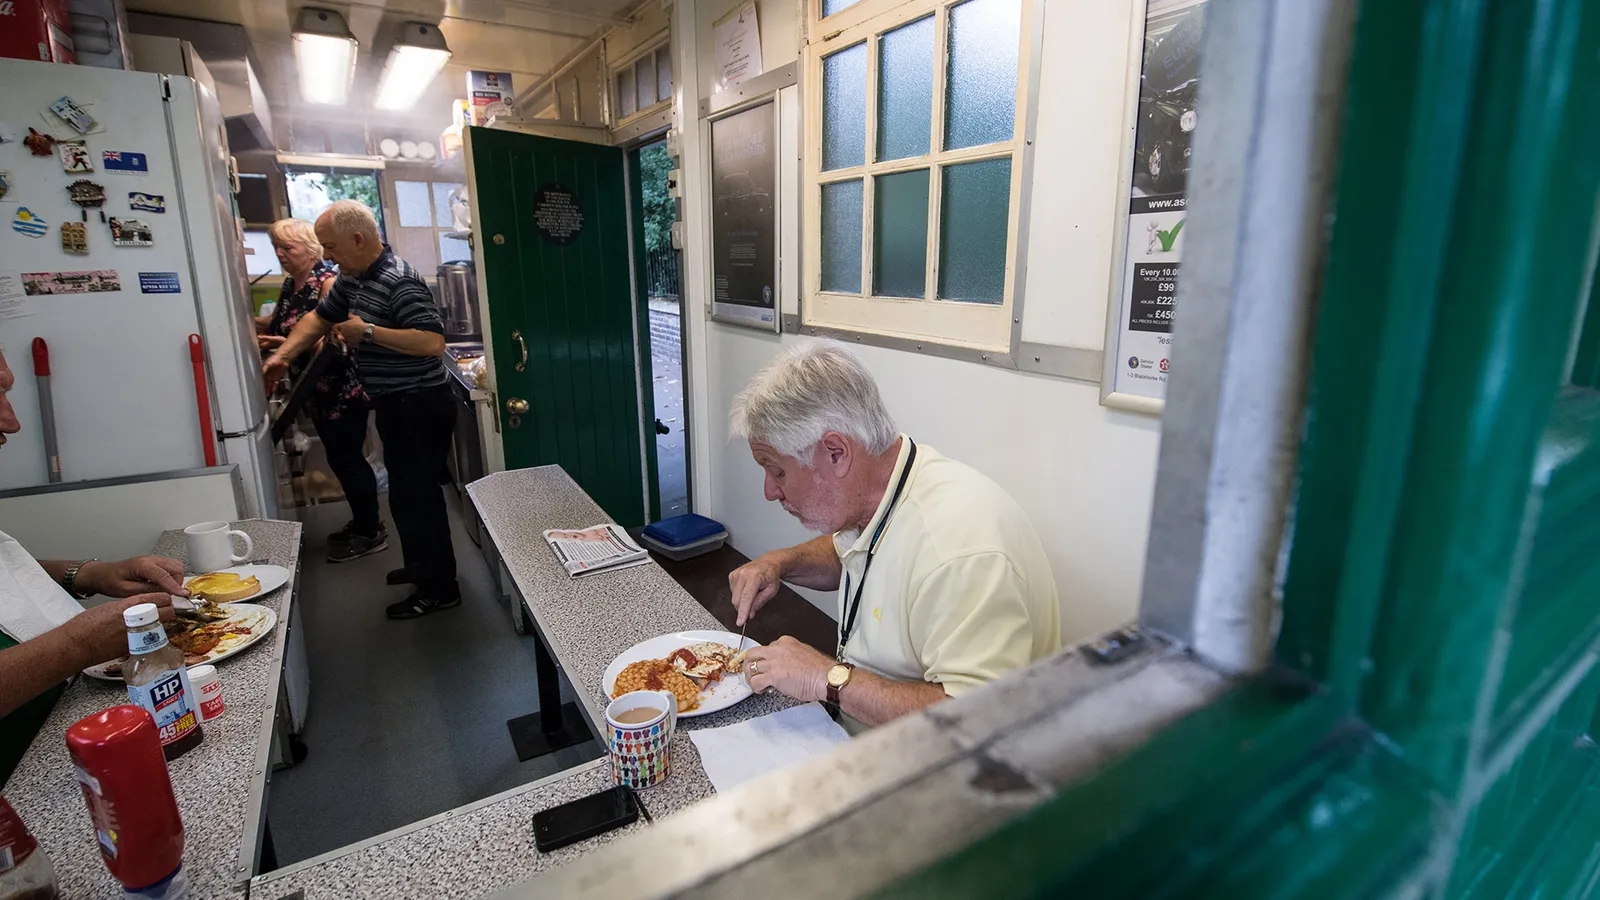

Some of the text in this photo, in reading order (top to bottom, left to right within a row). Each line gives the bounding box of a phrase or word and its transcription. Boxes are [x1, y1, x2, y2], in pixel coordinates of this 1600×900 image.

[1140, 268, 1160, 277] Every
[1158, 283, 1174, 292] £99
[1156, 296, 1177, 305] £225
[1155, 310, 1176, 319] £450
[154, 679, 180, 702] HP
[163, 696, 178, 706] SAUCE
[176, 718, 195, 732] FREE
